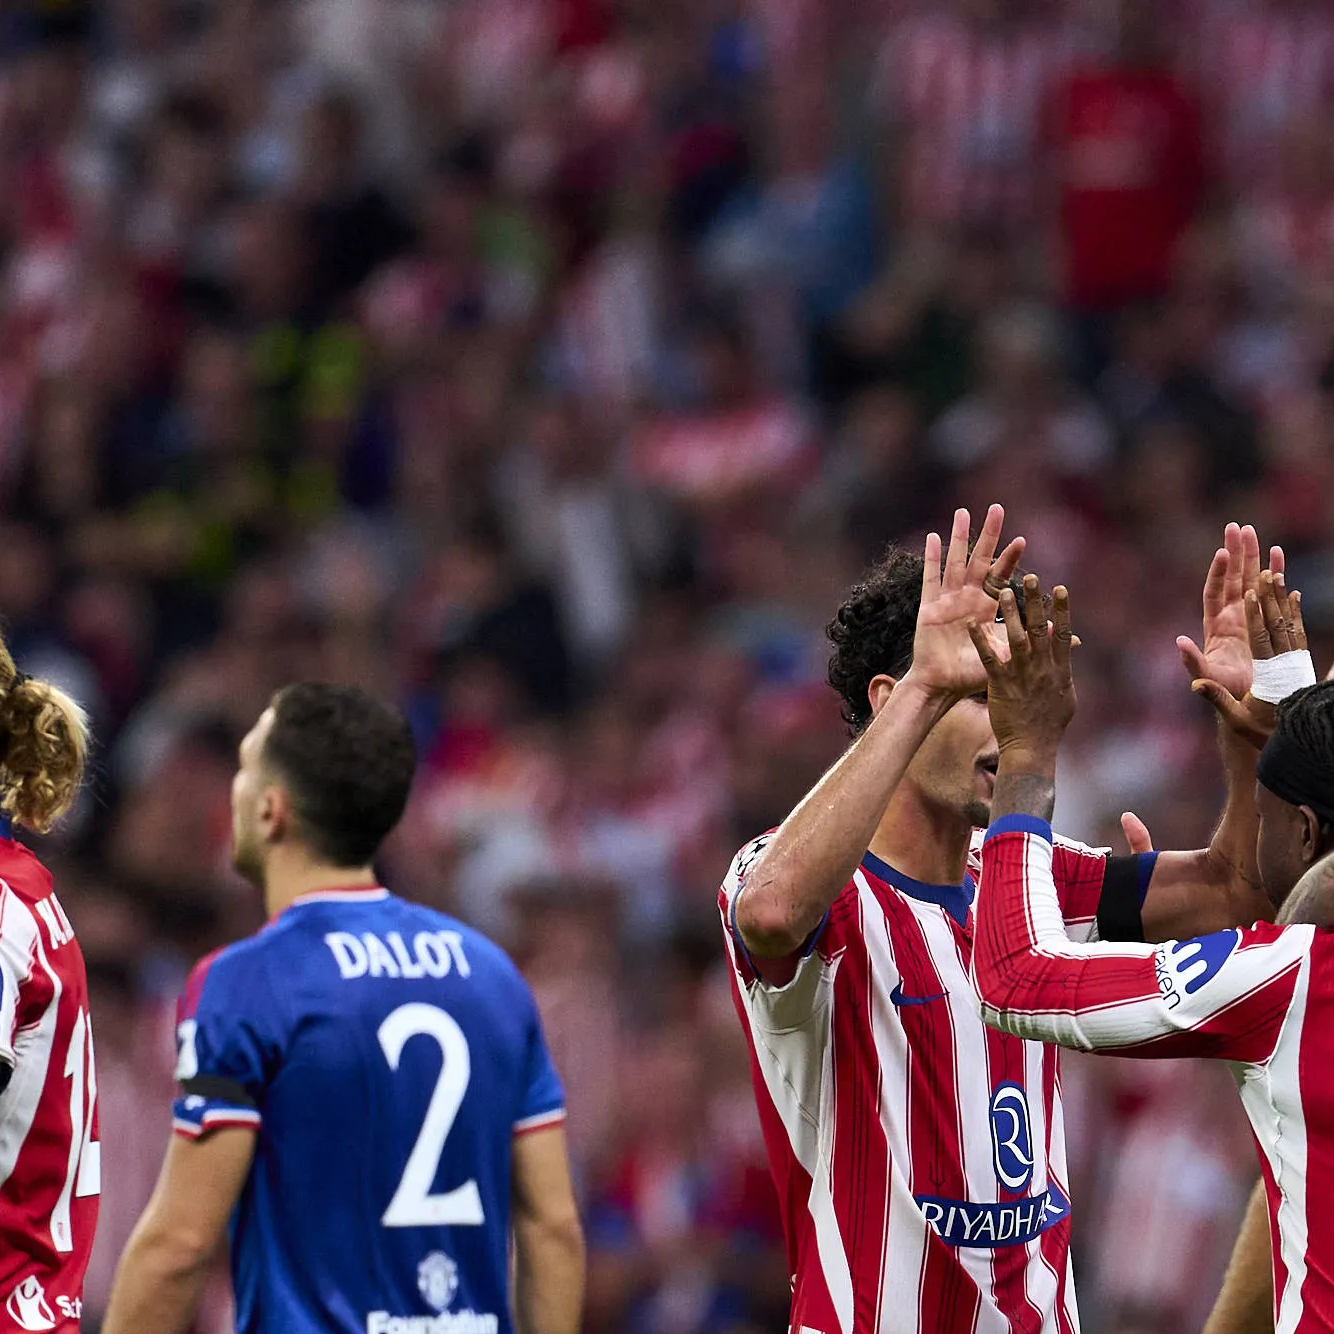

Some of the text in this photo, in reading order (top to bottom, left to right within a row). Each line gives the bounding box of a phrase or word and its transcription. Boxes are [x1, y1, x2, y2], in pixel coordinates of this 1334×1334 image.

[325, 930, 471, 979] DALOT
[377, 1002, 485, 1226] 2
[921, 1201, 1034, 1241] RIYADH
